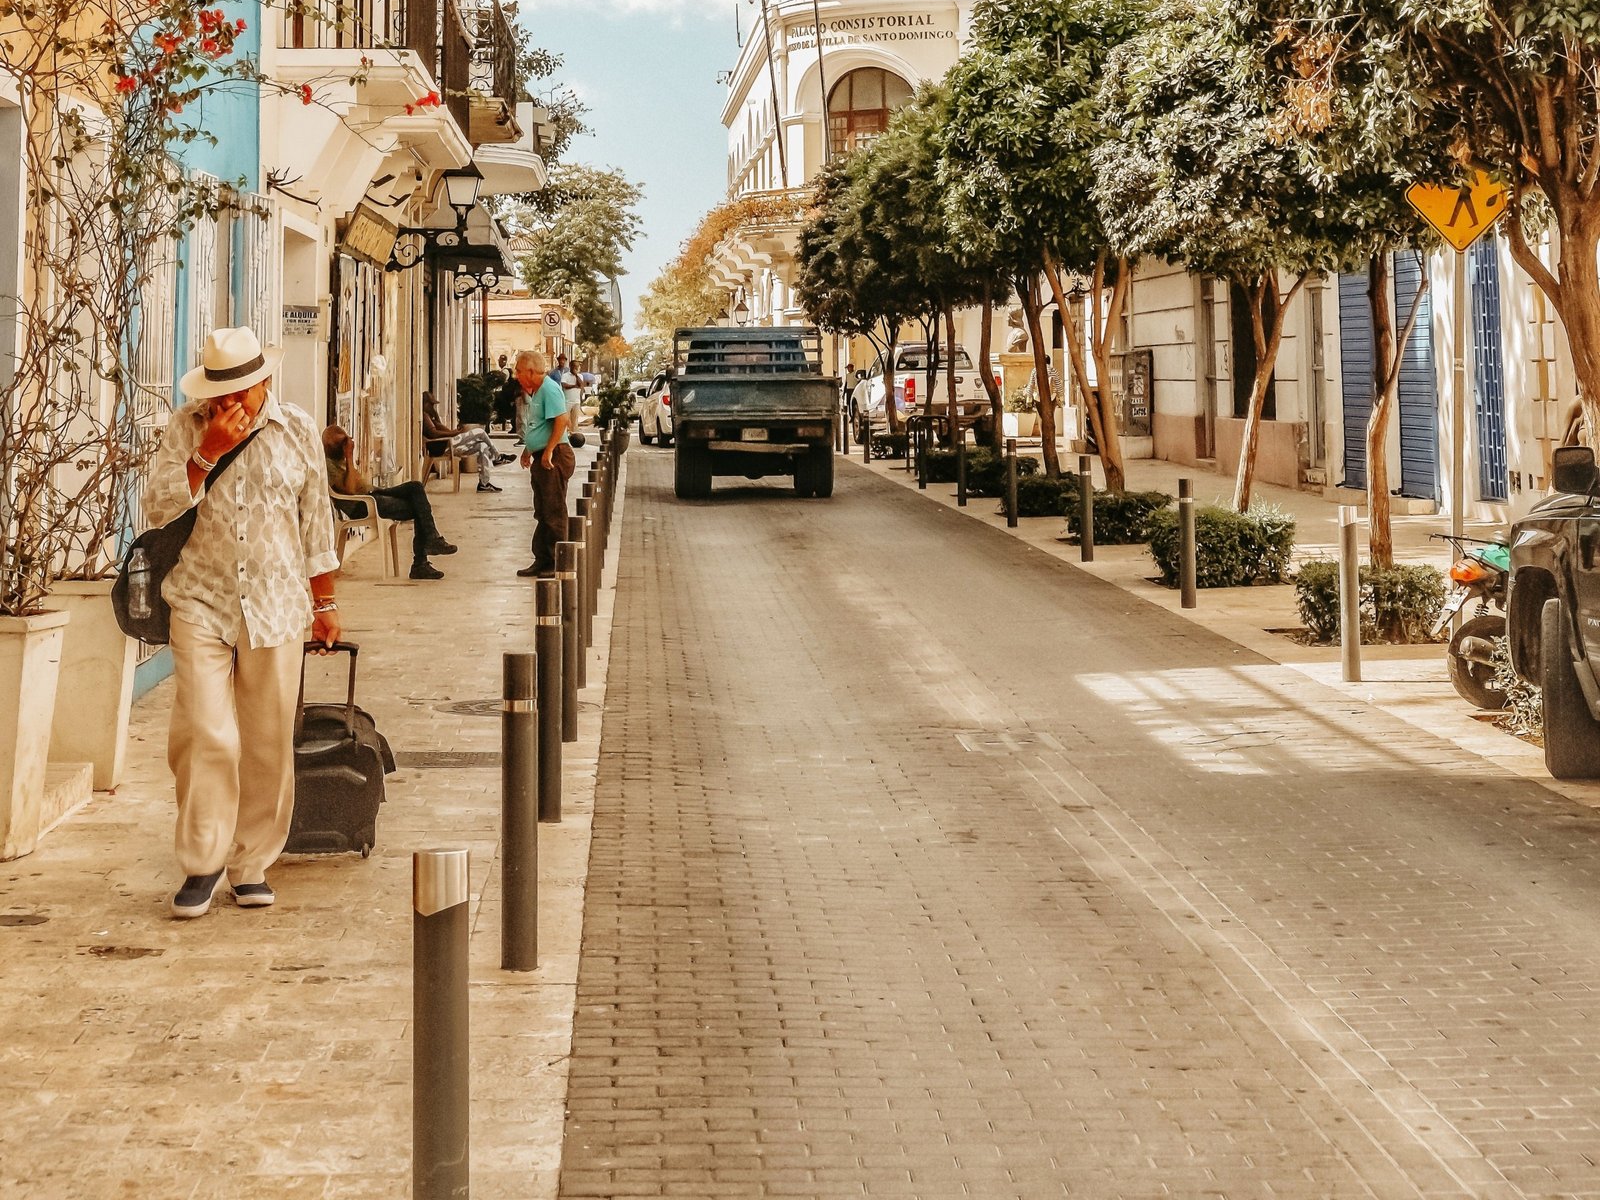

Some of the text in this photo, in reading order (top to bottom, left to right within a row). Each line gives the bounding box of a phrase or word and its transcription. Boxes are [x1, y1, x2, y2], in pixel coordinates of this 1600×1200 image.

[791, 14, 935, 39] PALACO CONSISTORIAL
[820, 36, 846, 47] VILLA
[848, 35, 860, 45] DE
[863, 31, 897, 43] SANTO
[898, 30, 954, 41] DOMINGO
